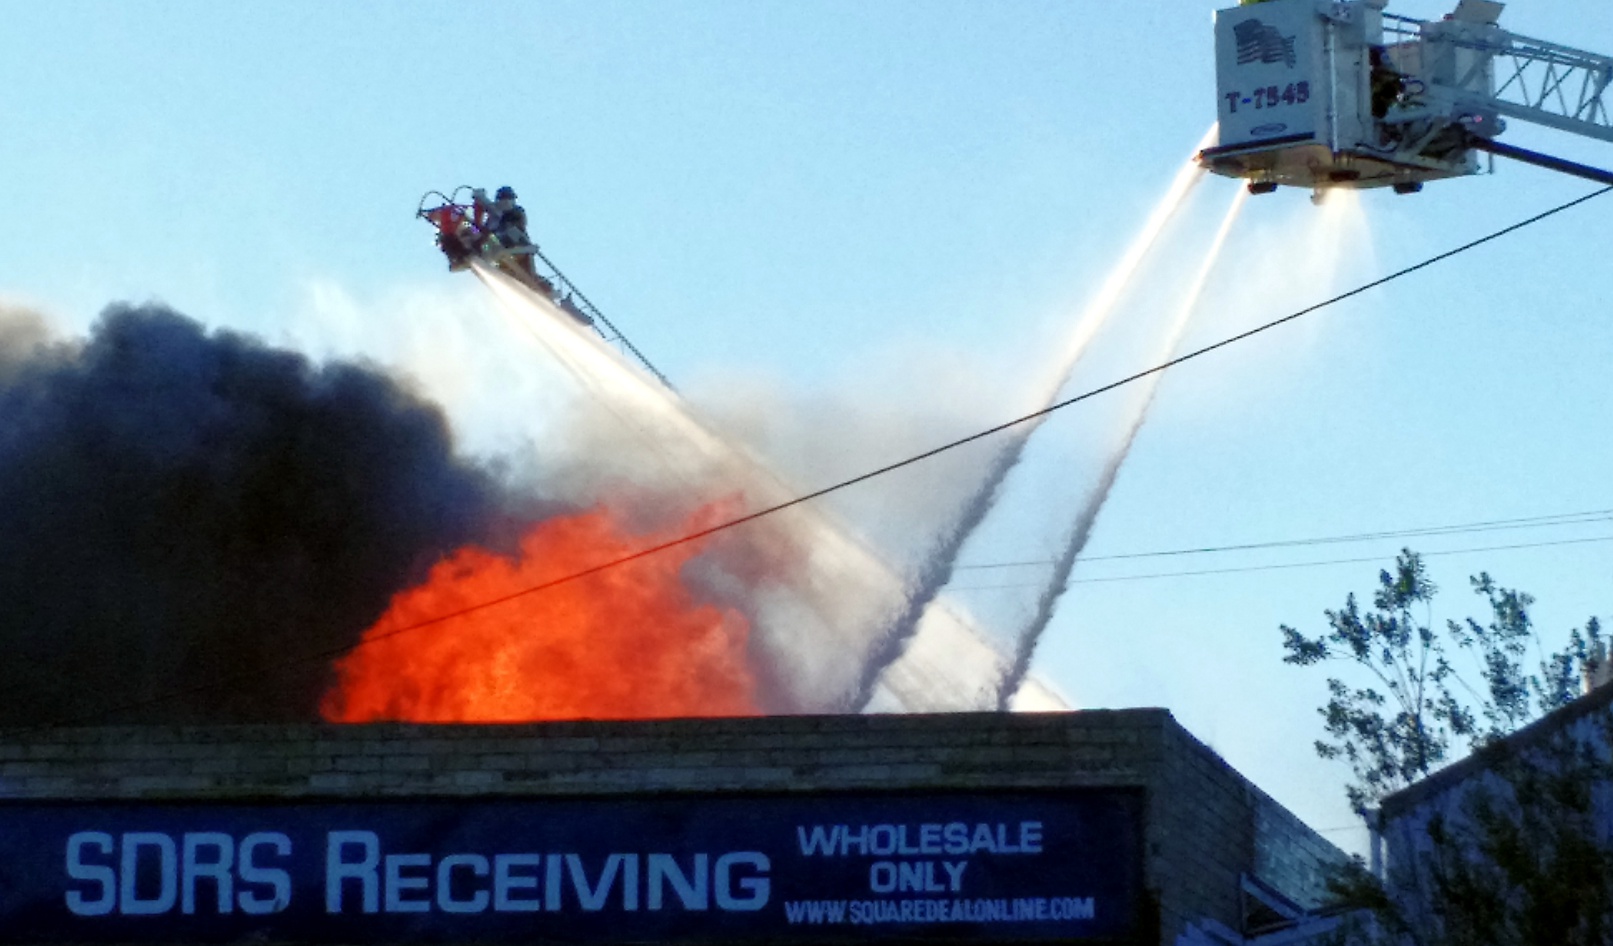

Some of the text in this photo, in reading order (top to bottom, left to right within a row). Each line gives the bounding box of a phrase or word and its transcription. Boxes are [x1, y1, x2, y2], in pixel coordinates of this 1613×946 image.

[797, 821, 1043, 856] WHOLESALE
[65, 831, 771, 915] SDRS RECEIVING
[870, 861, 968, 892] ONLY
